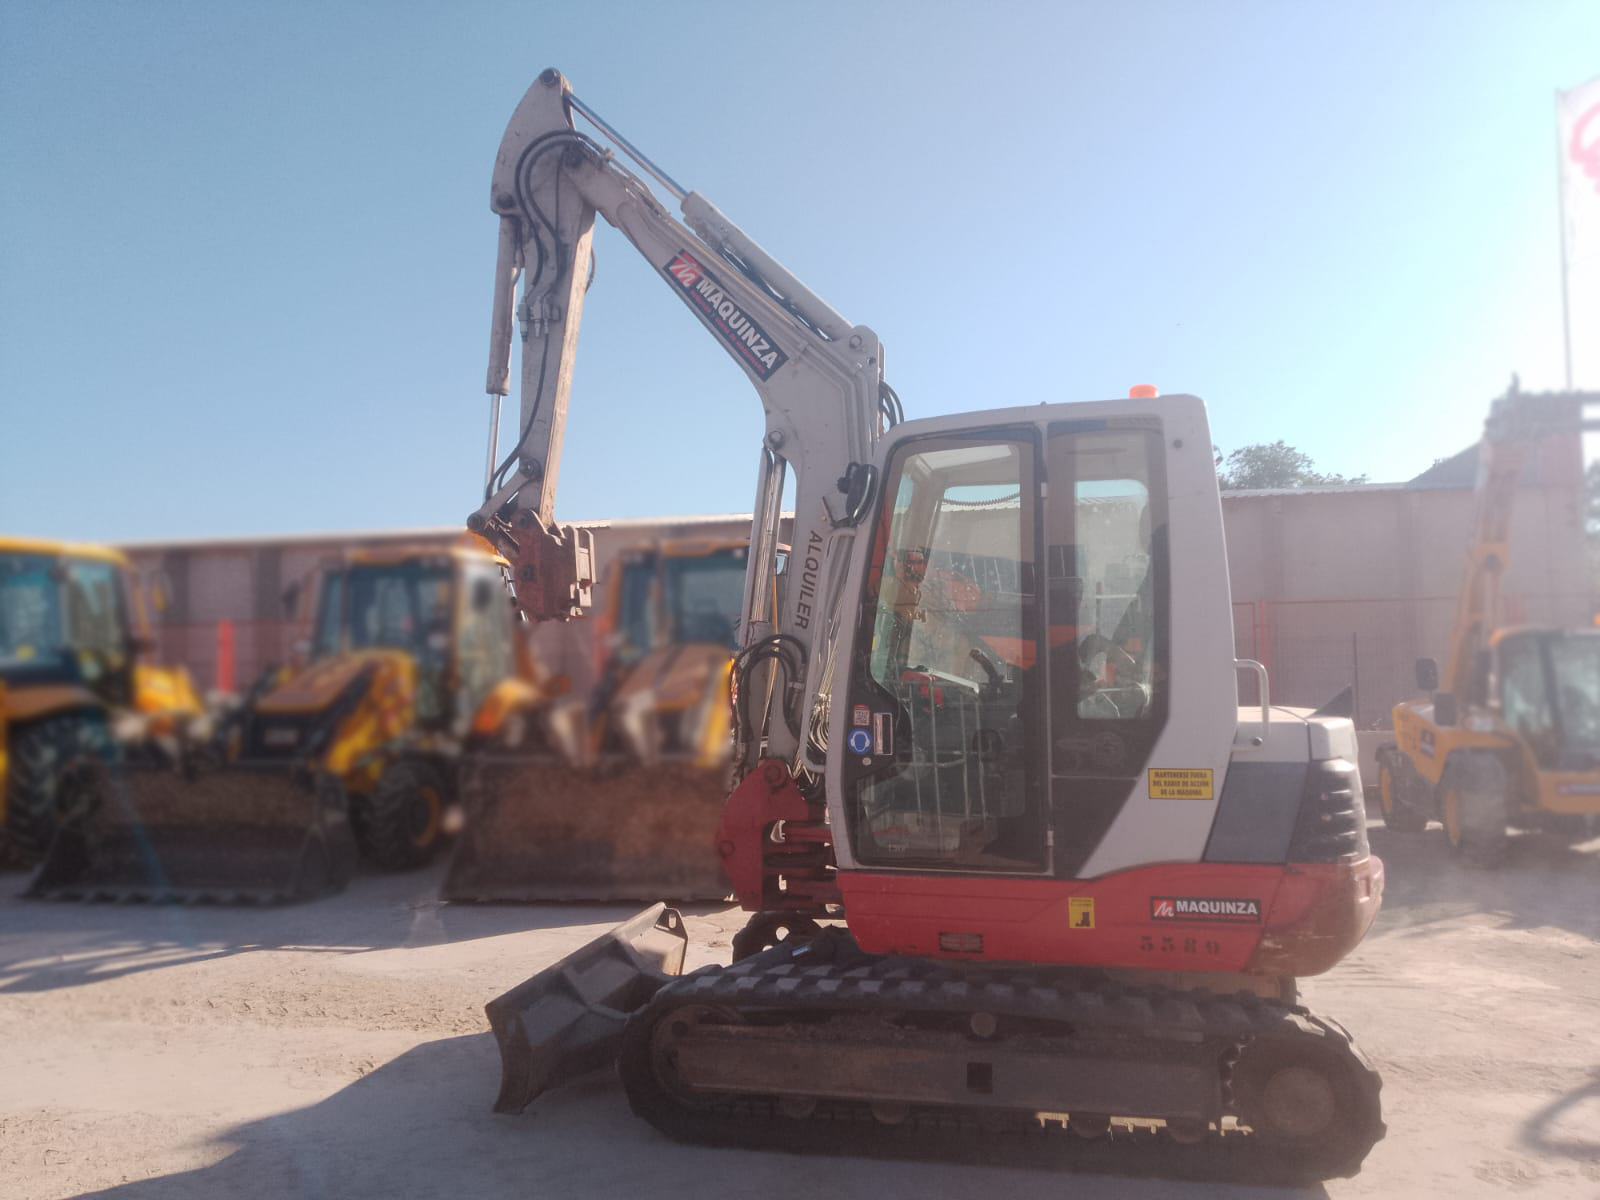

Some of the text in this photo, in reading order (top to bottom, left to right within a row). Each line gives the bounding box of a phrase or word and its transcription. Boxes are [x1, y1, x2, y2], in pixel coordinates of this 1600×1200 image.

[696, 278, 778, 369] MAQUINZA
[795, 530, 823, 629] ALQUILER
[1176, 900, 1258, 915] MAQUINZA
